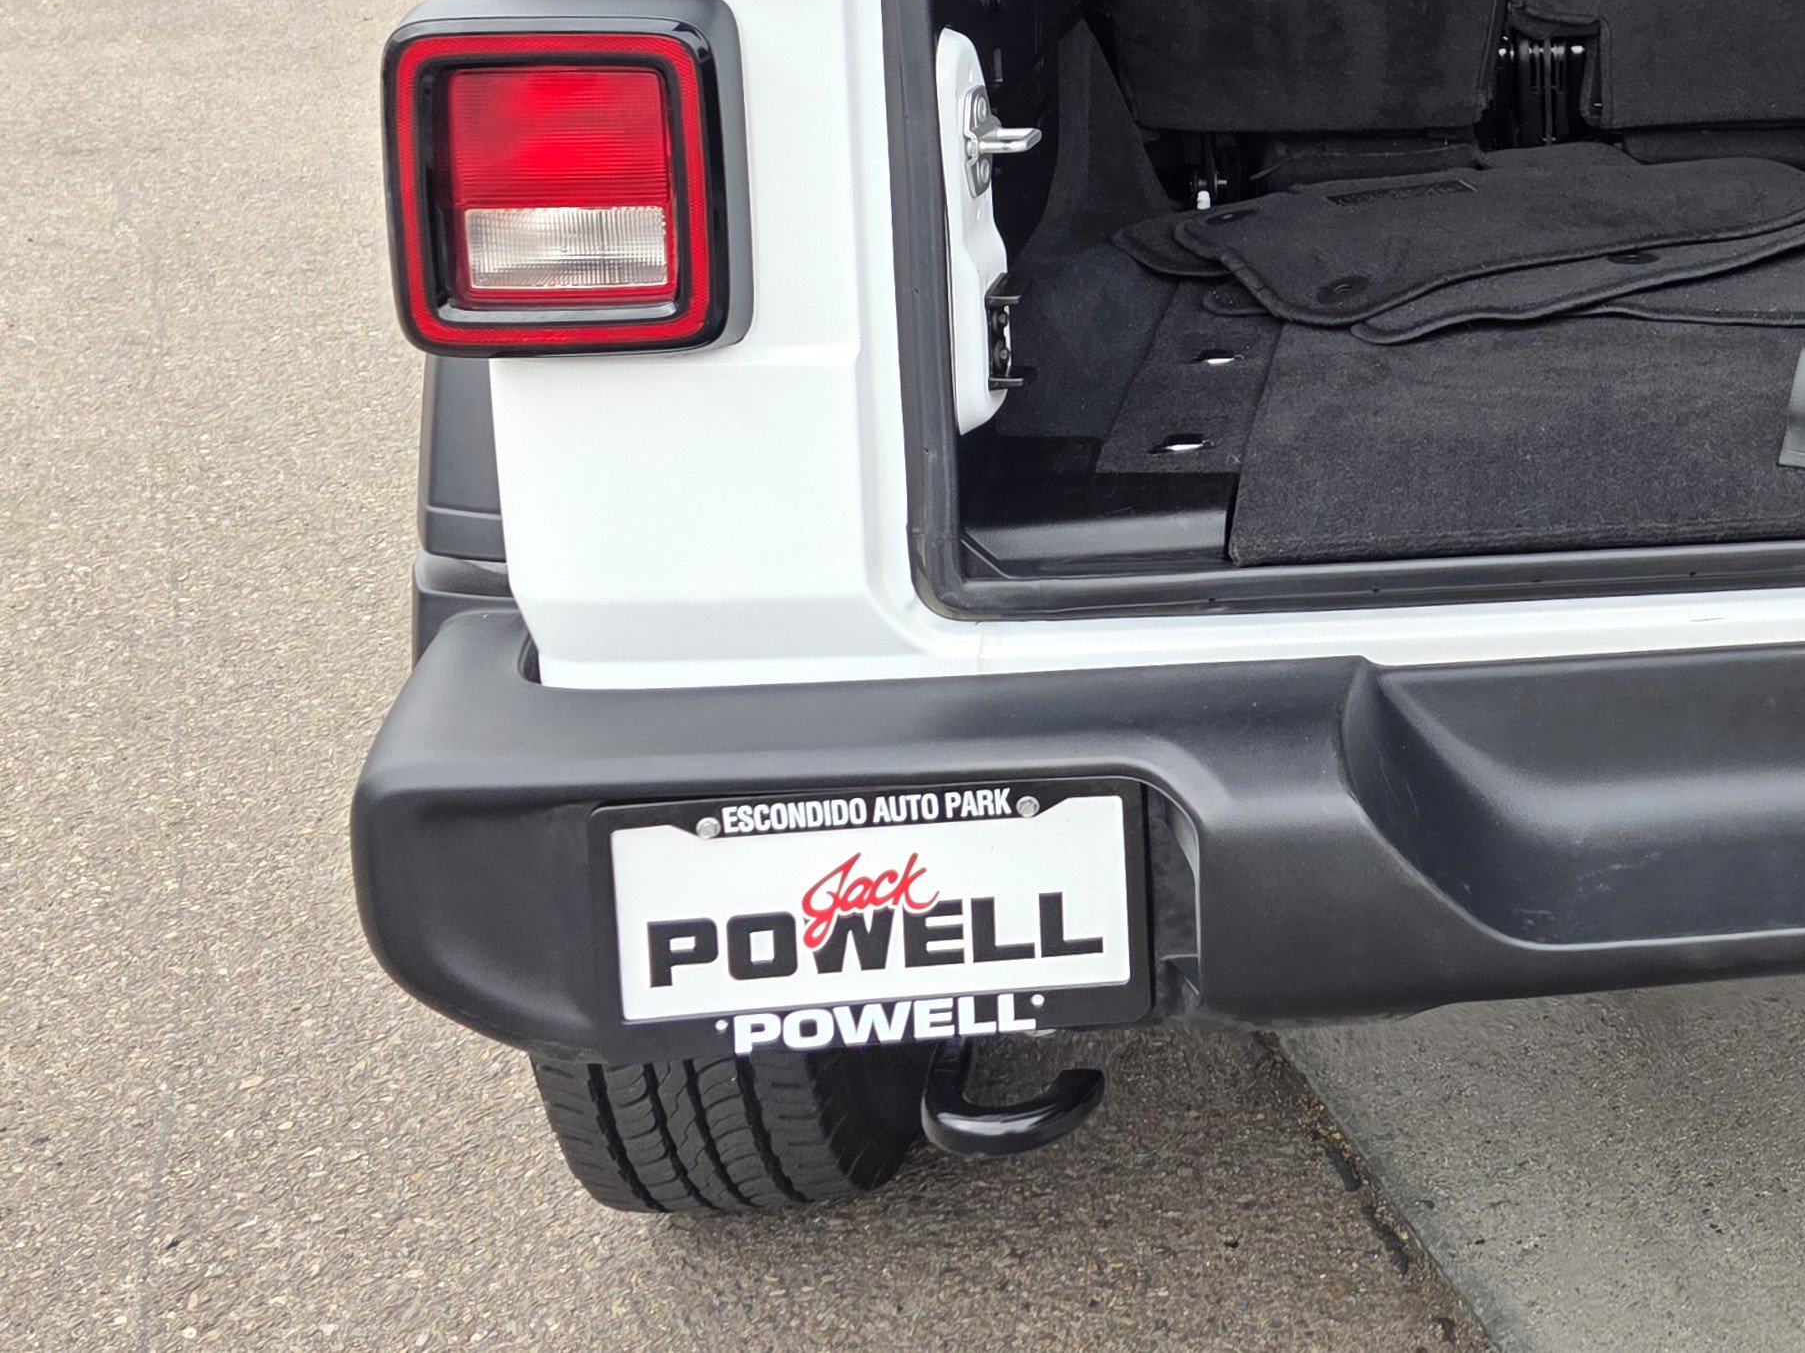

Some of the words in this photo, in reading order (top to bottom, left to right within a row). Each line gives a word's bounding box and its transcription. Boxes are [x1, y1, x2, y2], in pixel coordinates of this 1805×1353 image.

[723, 797, 867, 833] ESCONDIDO
[873, 793, 940, 822] AUTO
[945, 788, 1012, 818] PARK
[802, 852, 939, 949] Jack
[647, 892, 1104, 988] POWELL
[734, 993, 1036, 1054] POWELL
